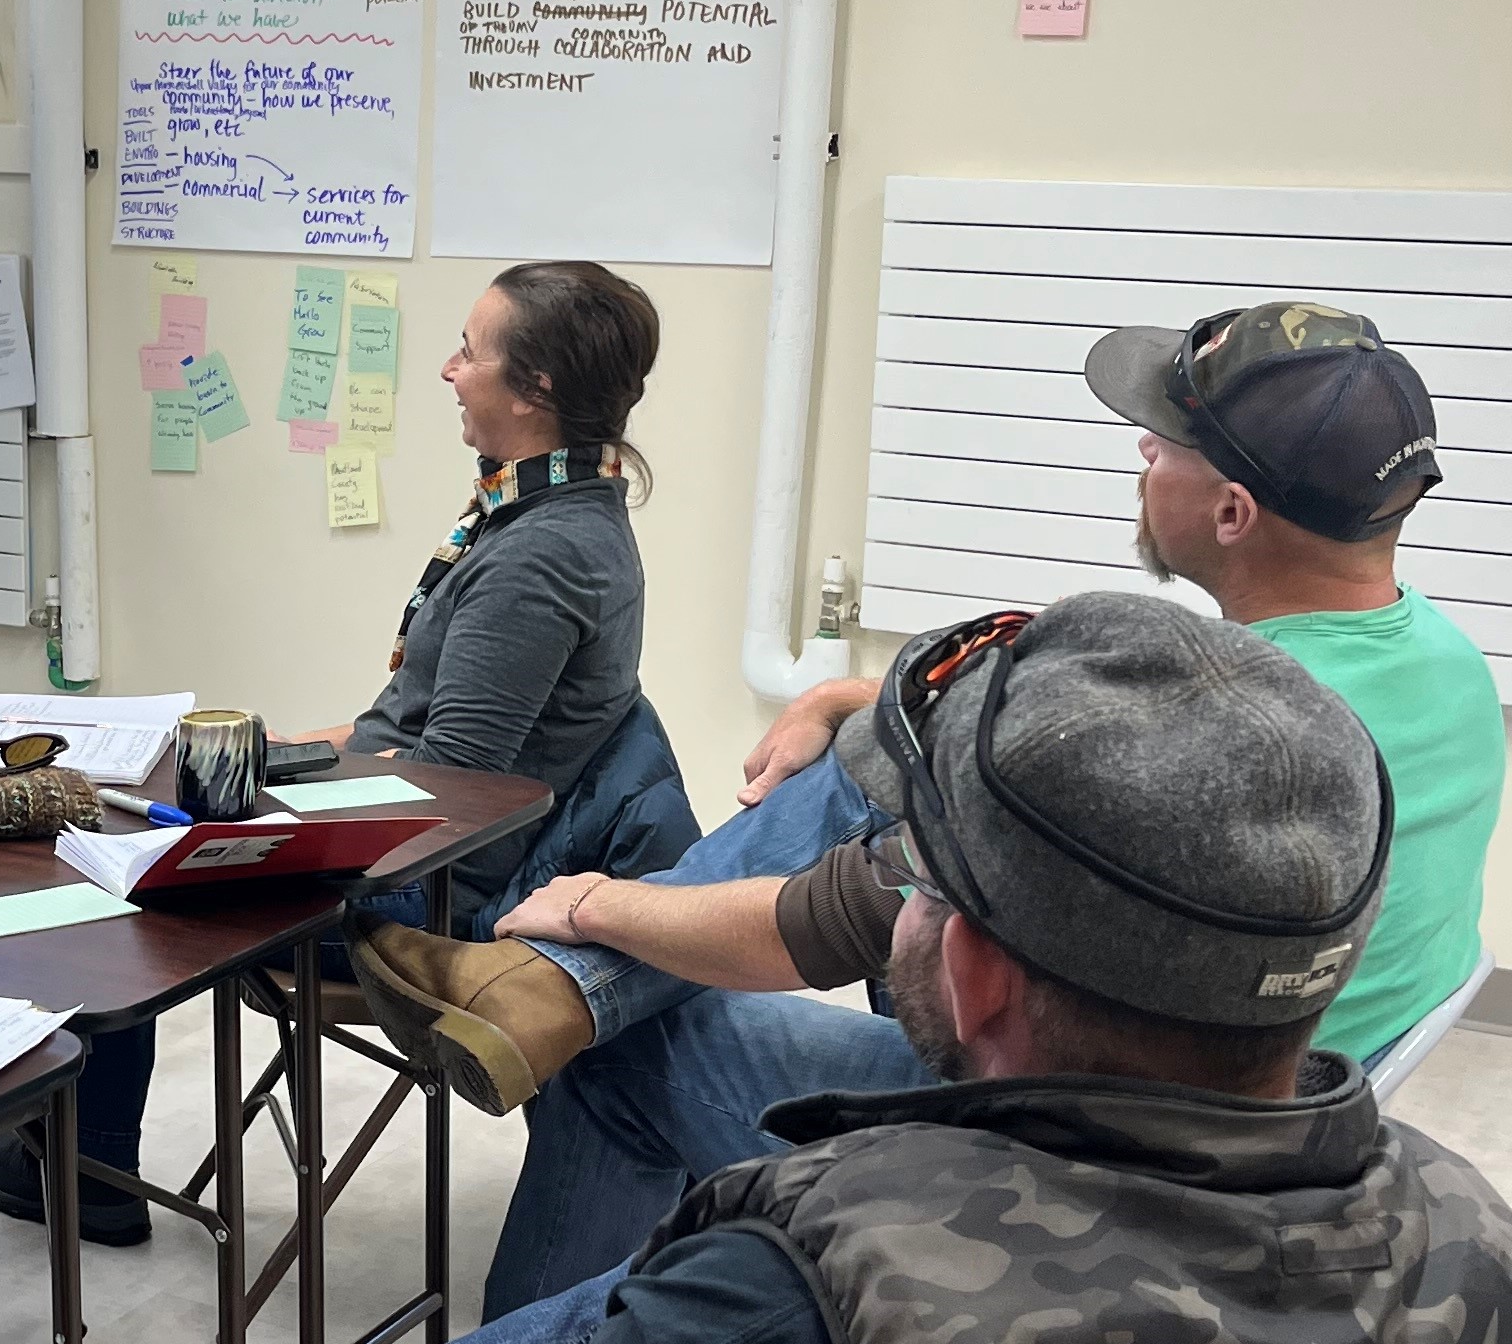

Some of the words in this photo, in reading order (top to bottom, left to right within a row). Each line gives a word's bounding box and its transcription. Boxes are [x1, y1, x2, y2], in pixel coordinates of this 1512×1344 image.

[167, 8, 208, 27] what
[217, 9, 241, 26] we
[253, 8, 300, 28] have
[463, 1, 520, 21] BUILD
[459, 35, 541, 58] THROUGH
[554, 38, 692, 64] COLLABORATION
[707, 44, 752, 64] AND
[158, 62, 202, 80] Steer
[210, 59, 237, 80] the
[245, 59, 295, 81] future
[302, 62, 317, 86] of
[324, 67, 355, 85] our
[469, 70, 595, 93] INVESTMENT
[162, 89, 242, 108] community
[262, 88, 295, 108] how
[301, 93, 324, 109] we
[214, 119, 246, 137] etc
[183, 146, 238, 182] housing
[382, 185, 410, 207] for
[303, 209, 366, 226] current
[305, 225, 389, 252] community
[294, 289, 308, 301] To
[1375, 451, 1403, 481] MADE
